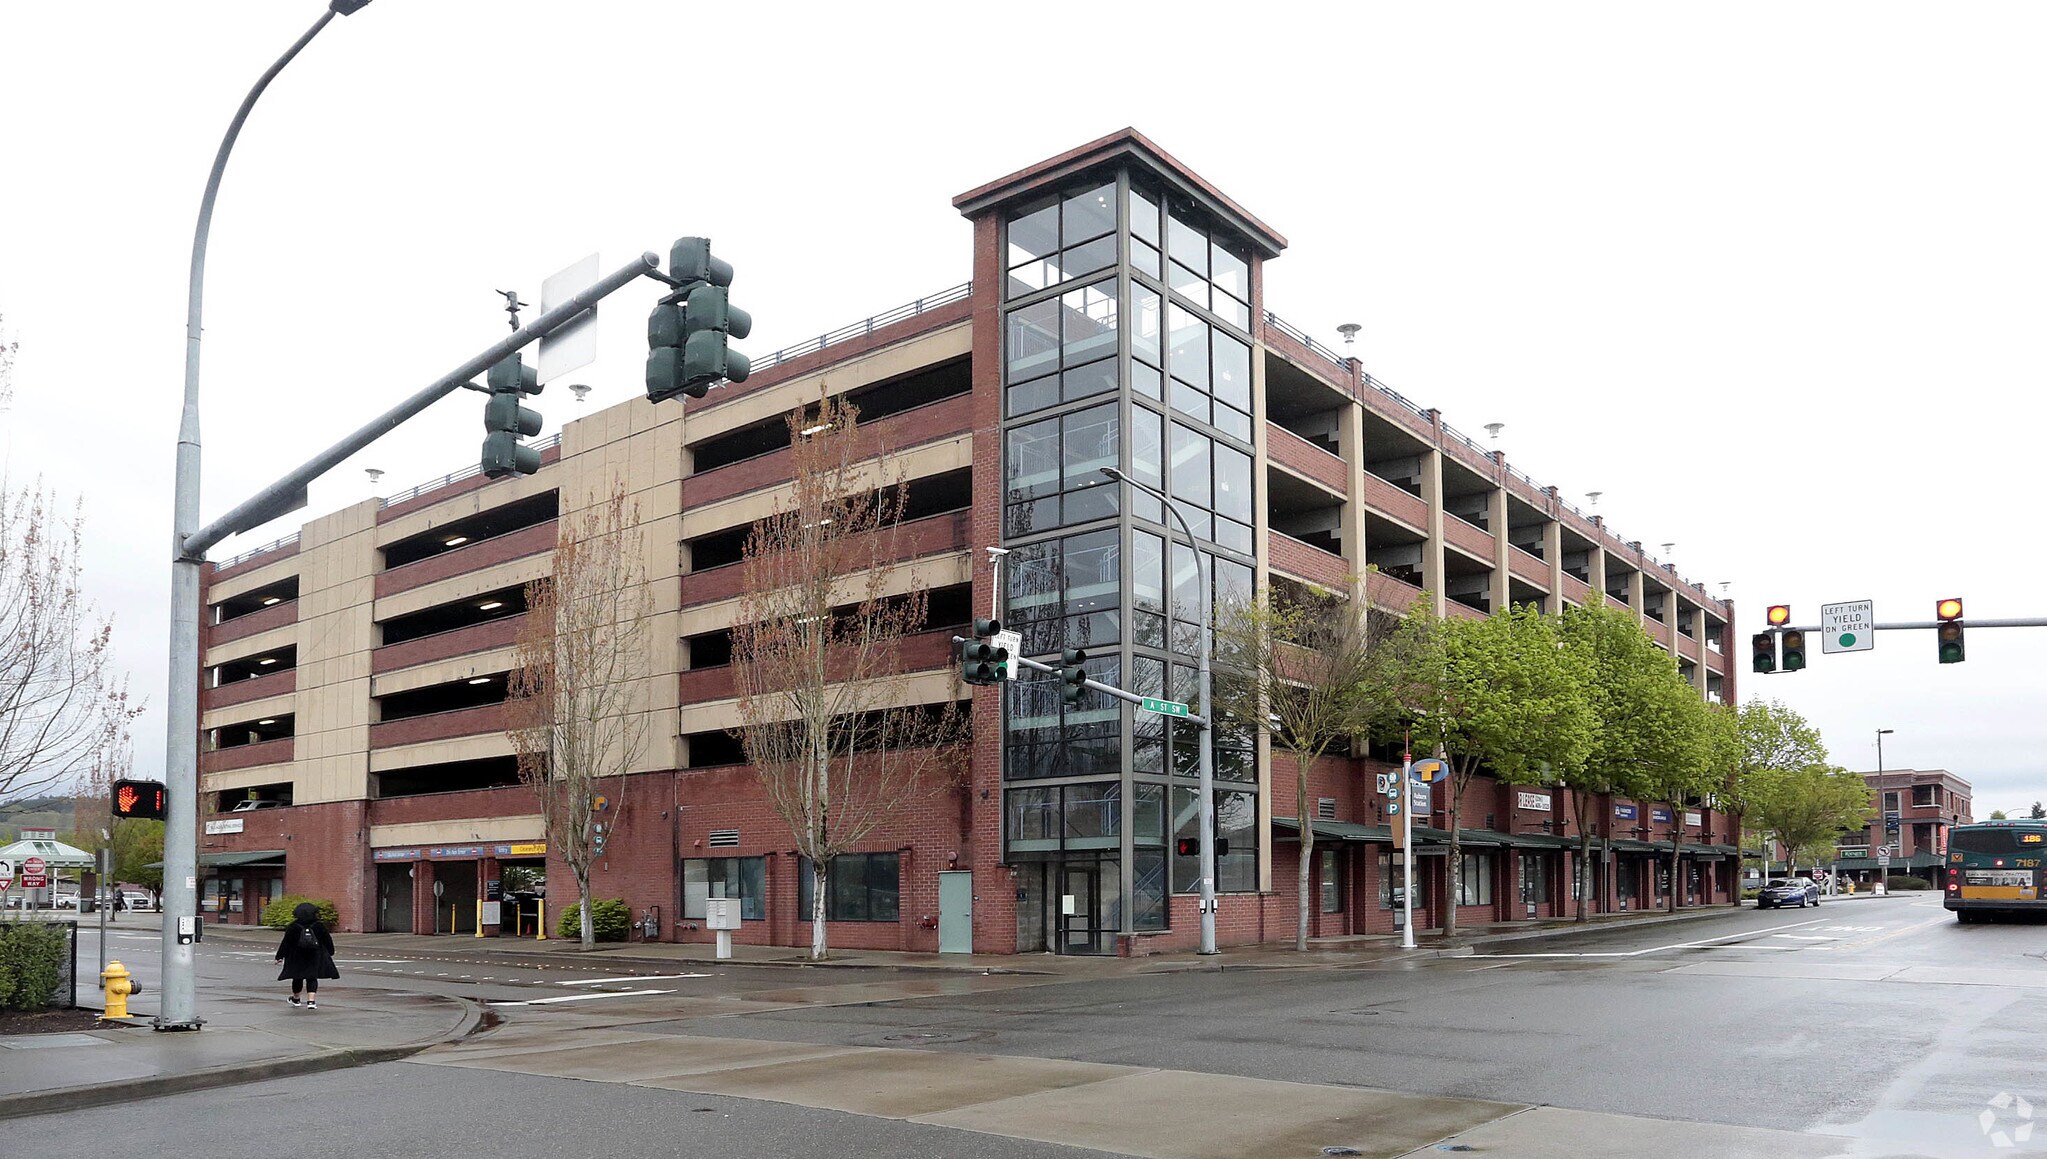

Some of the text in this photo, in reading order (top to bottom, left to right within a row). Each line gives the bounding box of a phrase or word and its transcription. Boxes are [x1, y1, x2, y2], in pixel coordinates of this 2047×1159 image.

[1824, 604, 1869, 615] LEFT TURN
[1833, 613, 1862, 624] YIELD
[1841, 622, 1870, 632] GREEN
[1150, 701, 1181, 713] A ST SW
[1389, 804, 1398, 814] P
[2015, 859, 2042, 868] 7187
